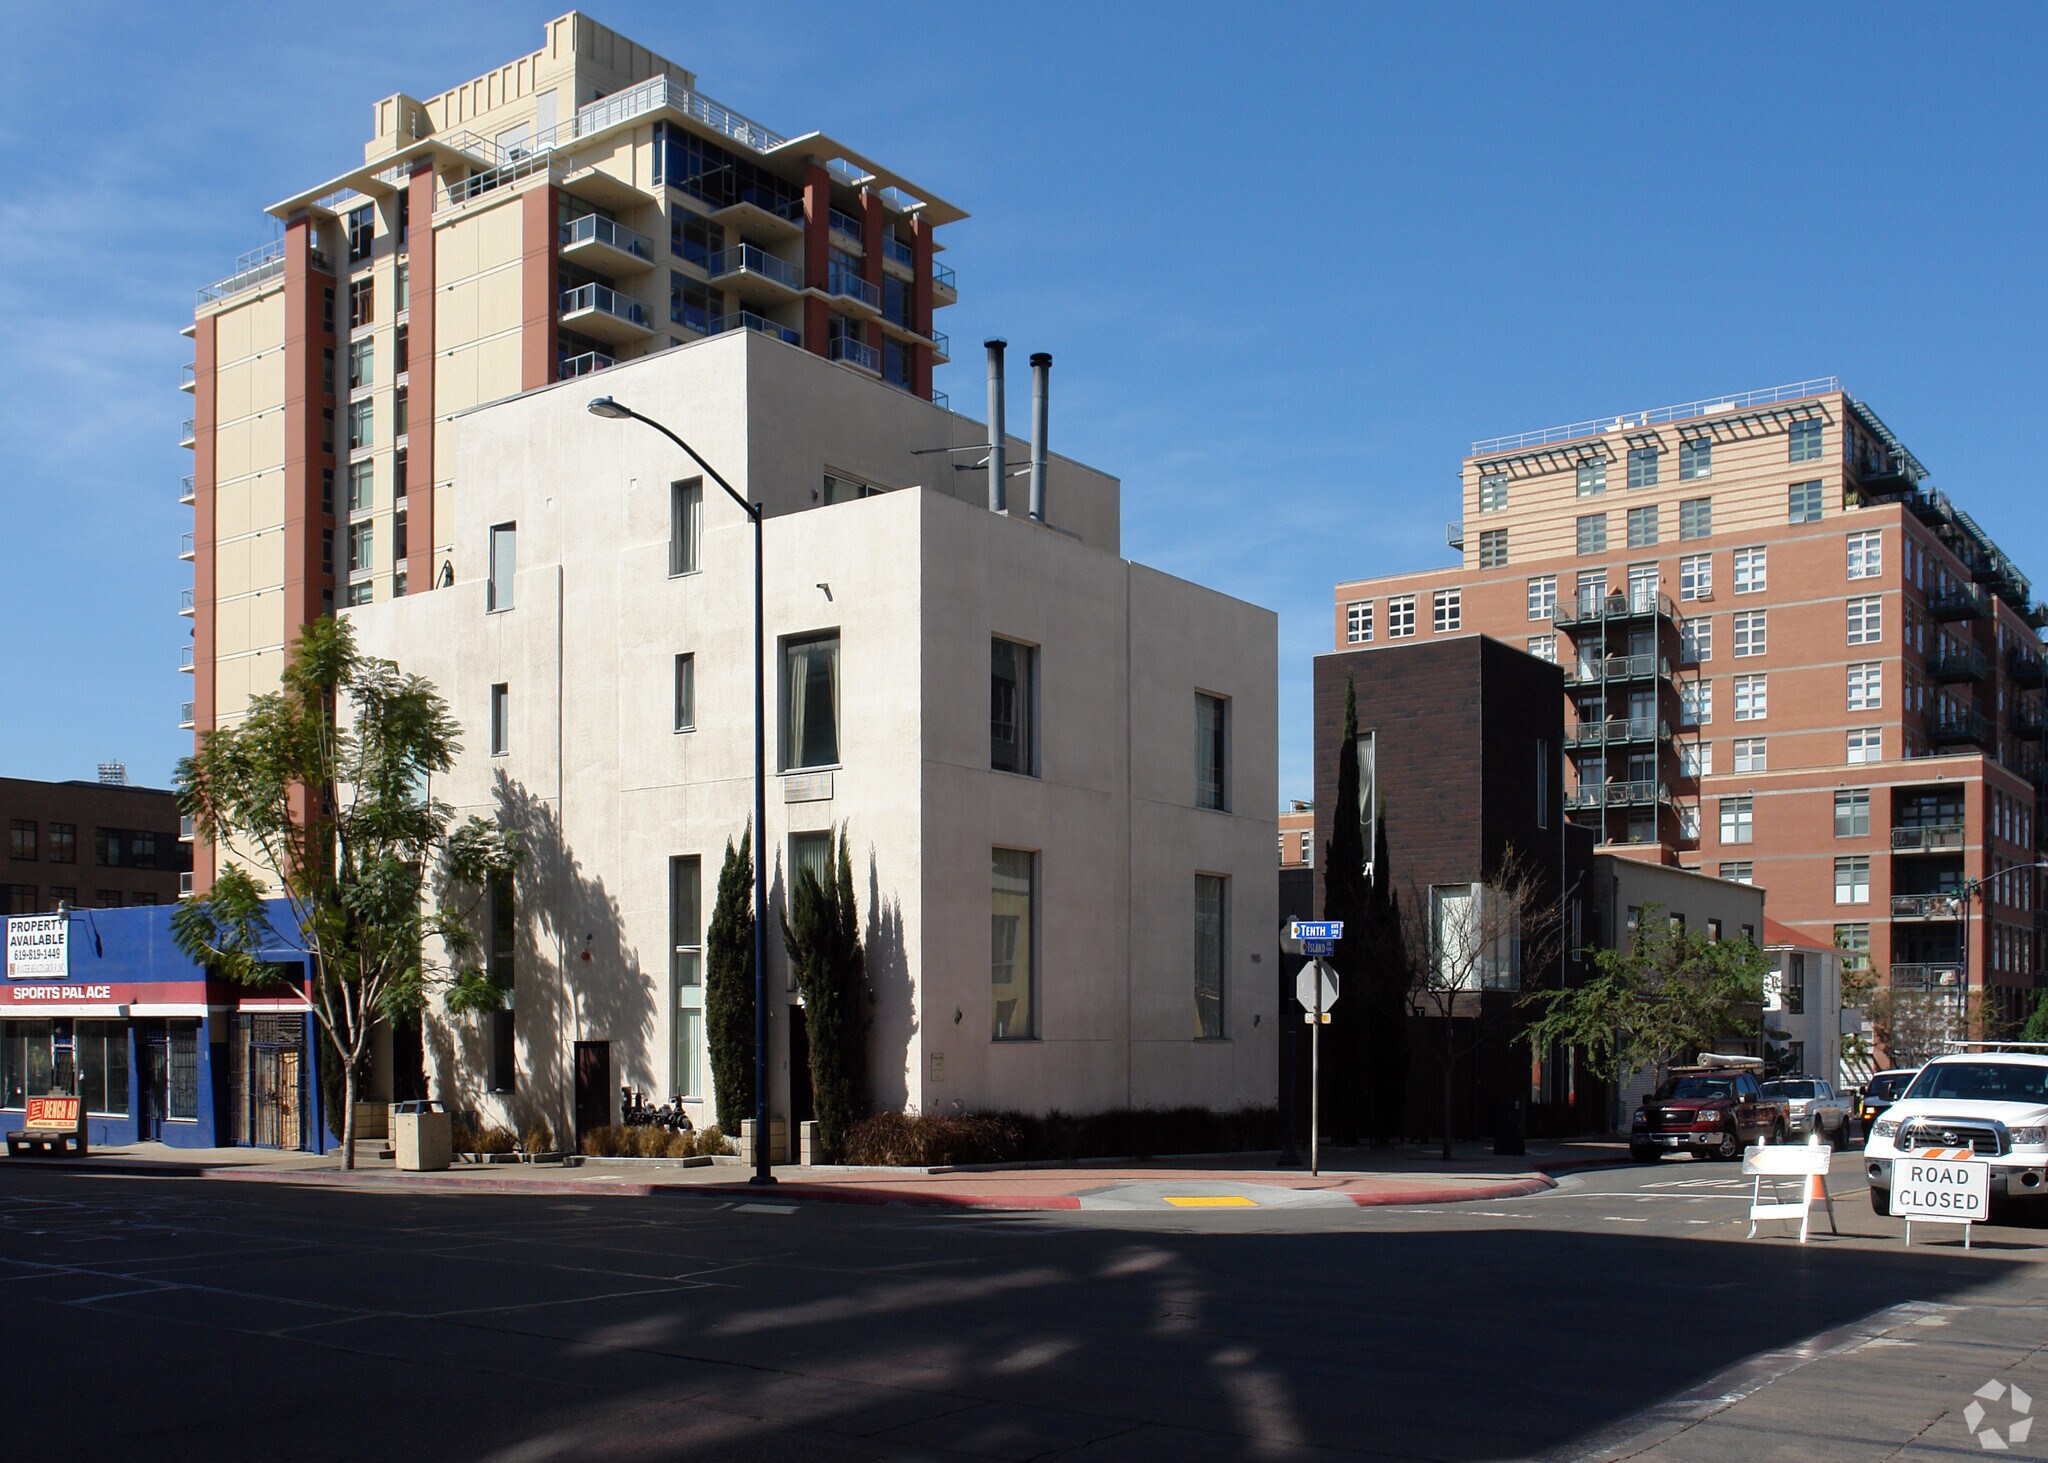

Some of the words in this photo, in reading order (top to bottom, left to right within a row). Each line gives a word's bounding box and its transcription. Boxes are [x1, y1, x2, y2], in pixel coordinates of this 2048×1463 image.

[11, 919, 64, 932] PROPERTY
[1301, 925, 1326, 936] TENTH
[10, 933, 65, 947] AVAILABLE
[1307, 941, 1326, 953] ISLAND
[13, 986, 60, 1000] SPORTS
[62, 985, 110, 999] PALACE
[43, 1100, 67, 1119] BENCH
[67, 1100, 78, 1119] AD
[1911, 1166, 1969, 1185] ROAD
[1899, 1190, 1979, 1210] CLOSED
